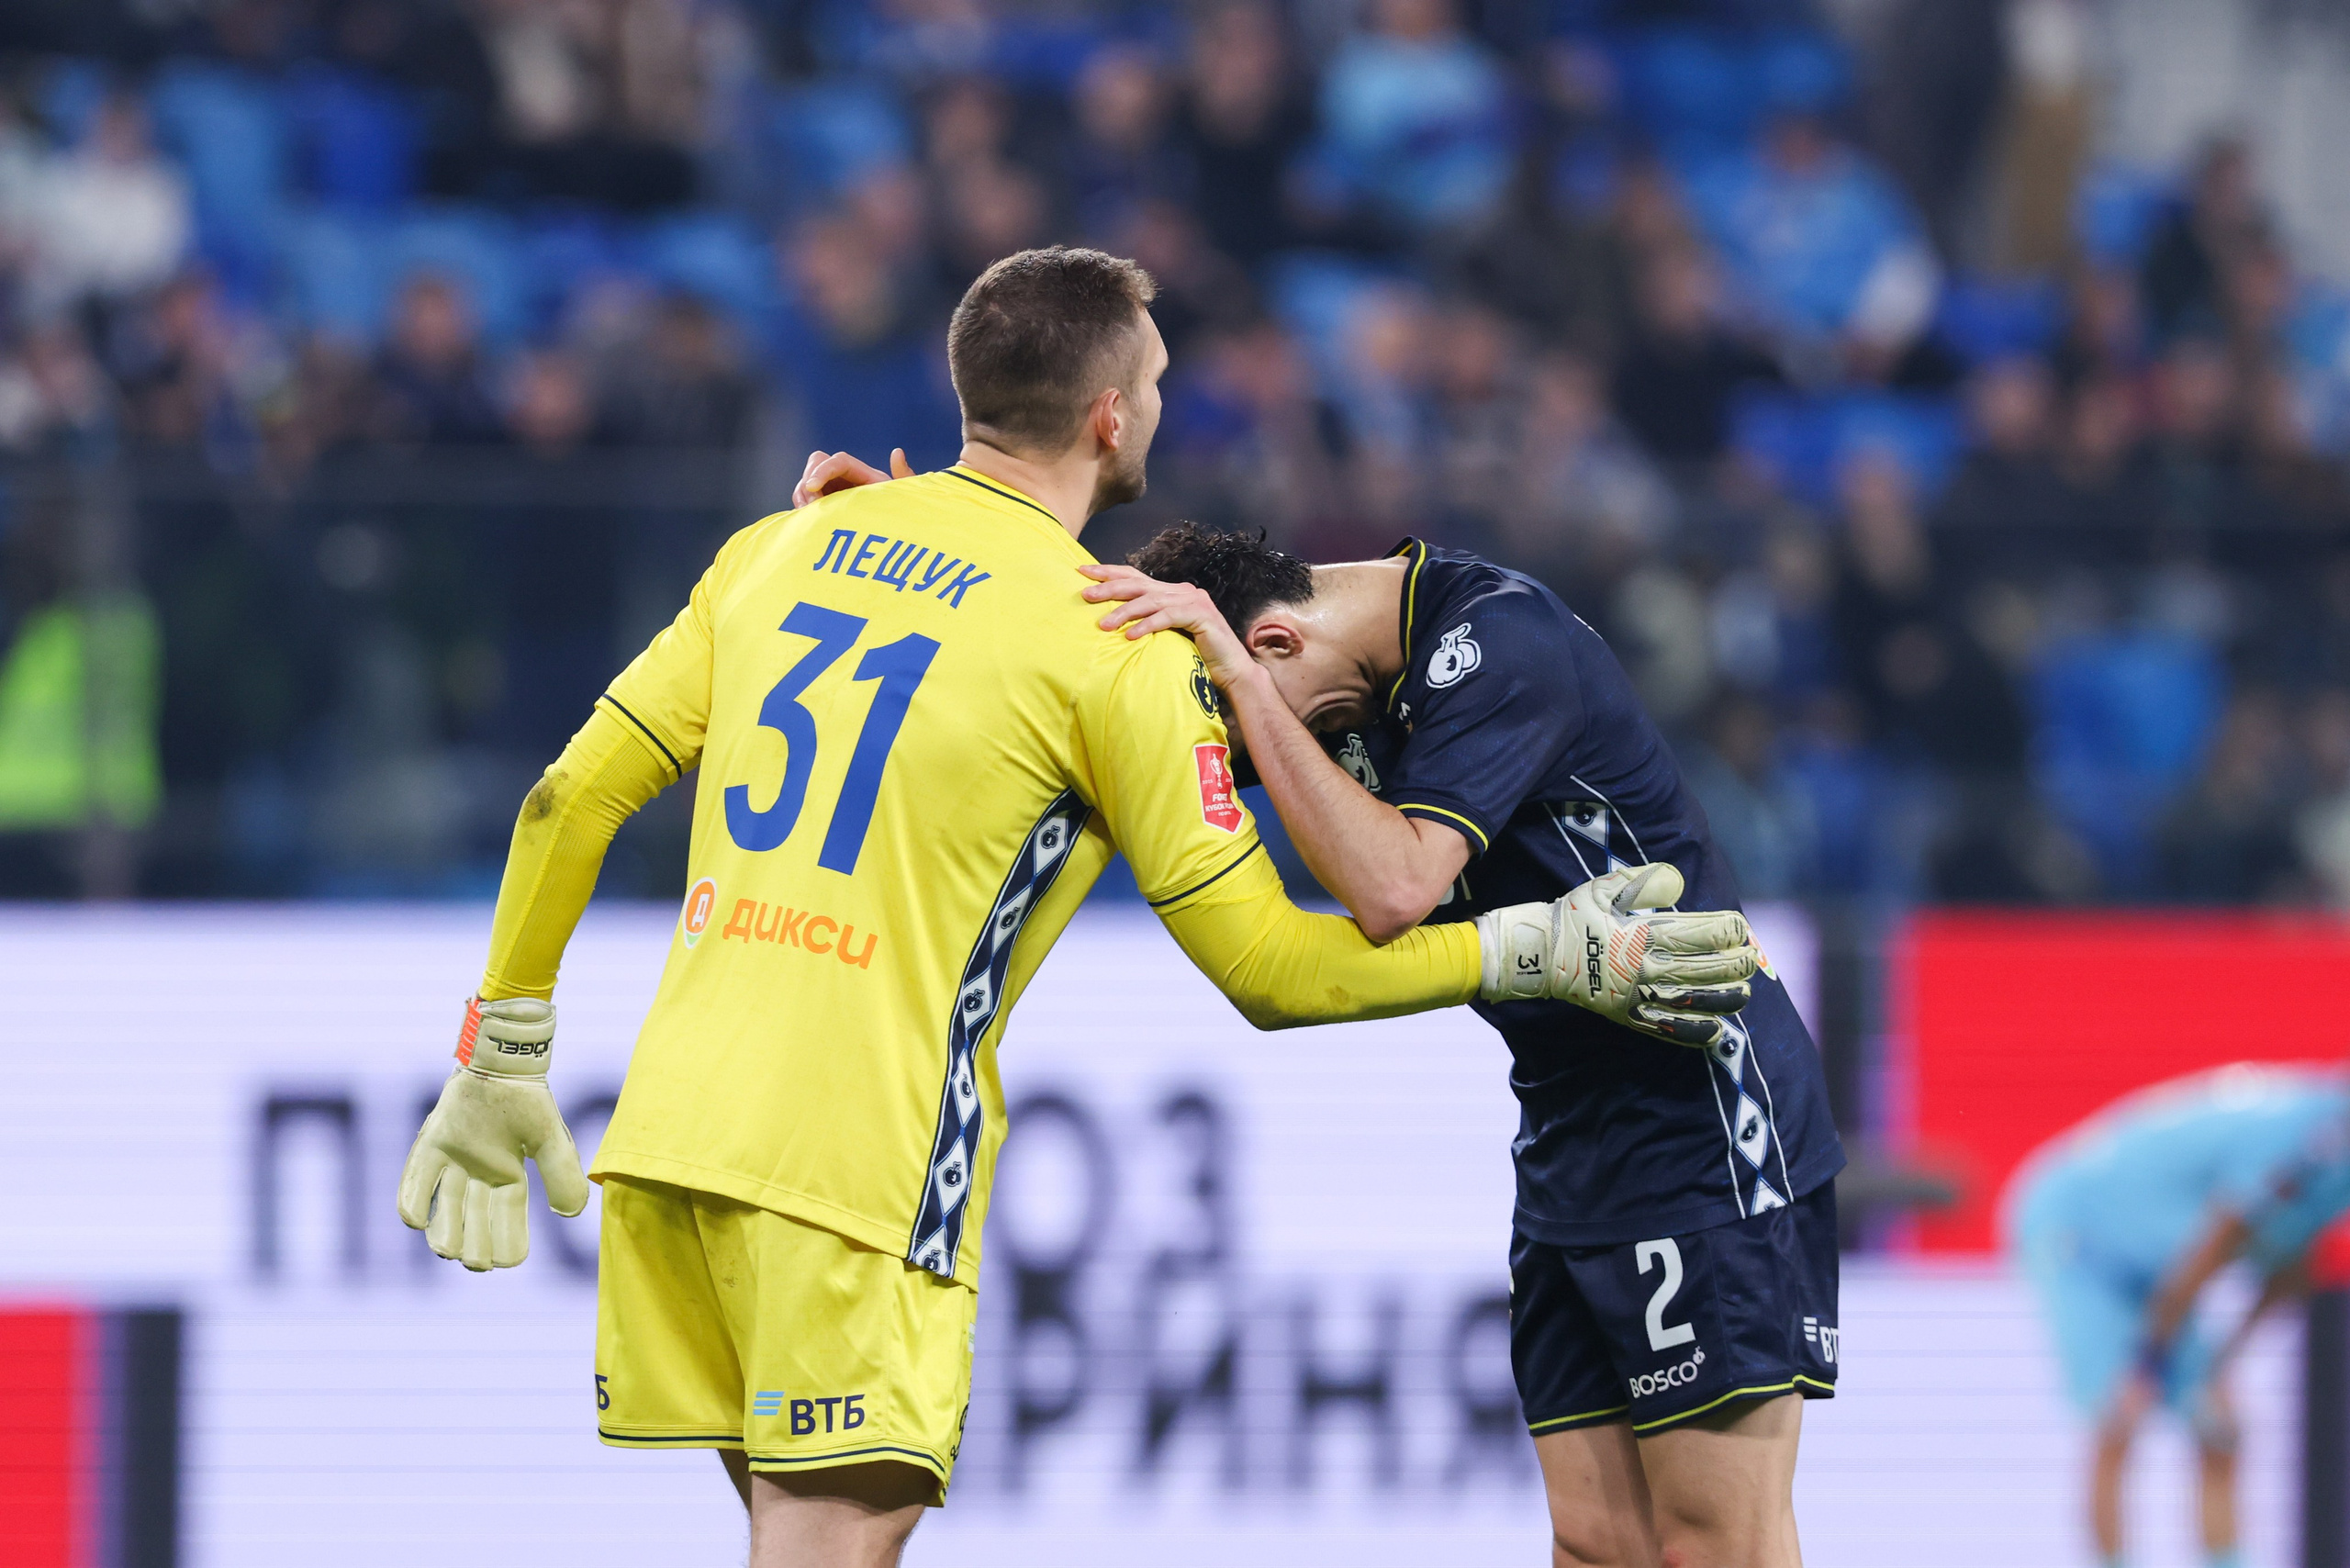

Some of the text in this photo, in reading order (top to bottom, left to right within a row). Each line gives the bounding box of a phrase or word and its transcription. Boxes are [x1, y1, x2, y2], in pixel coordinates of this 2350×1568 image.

[813, 529, 992, 610] ЛЕЩУК
[724, 601, 942, 876] 31
[1517, 954, 1542, 975] 31
[1586, 925, 1604, 998] JÖGEL
[1634, 1237, 1696, 1353] 2
[789, 1394, 866, 1436] ВТБ
[1628, 1361, 1698, 1399] BOSCO
